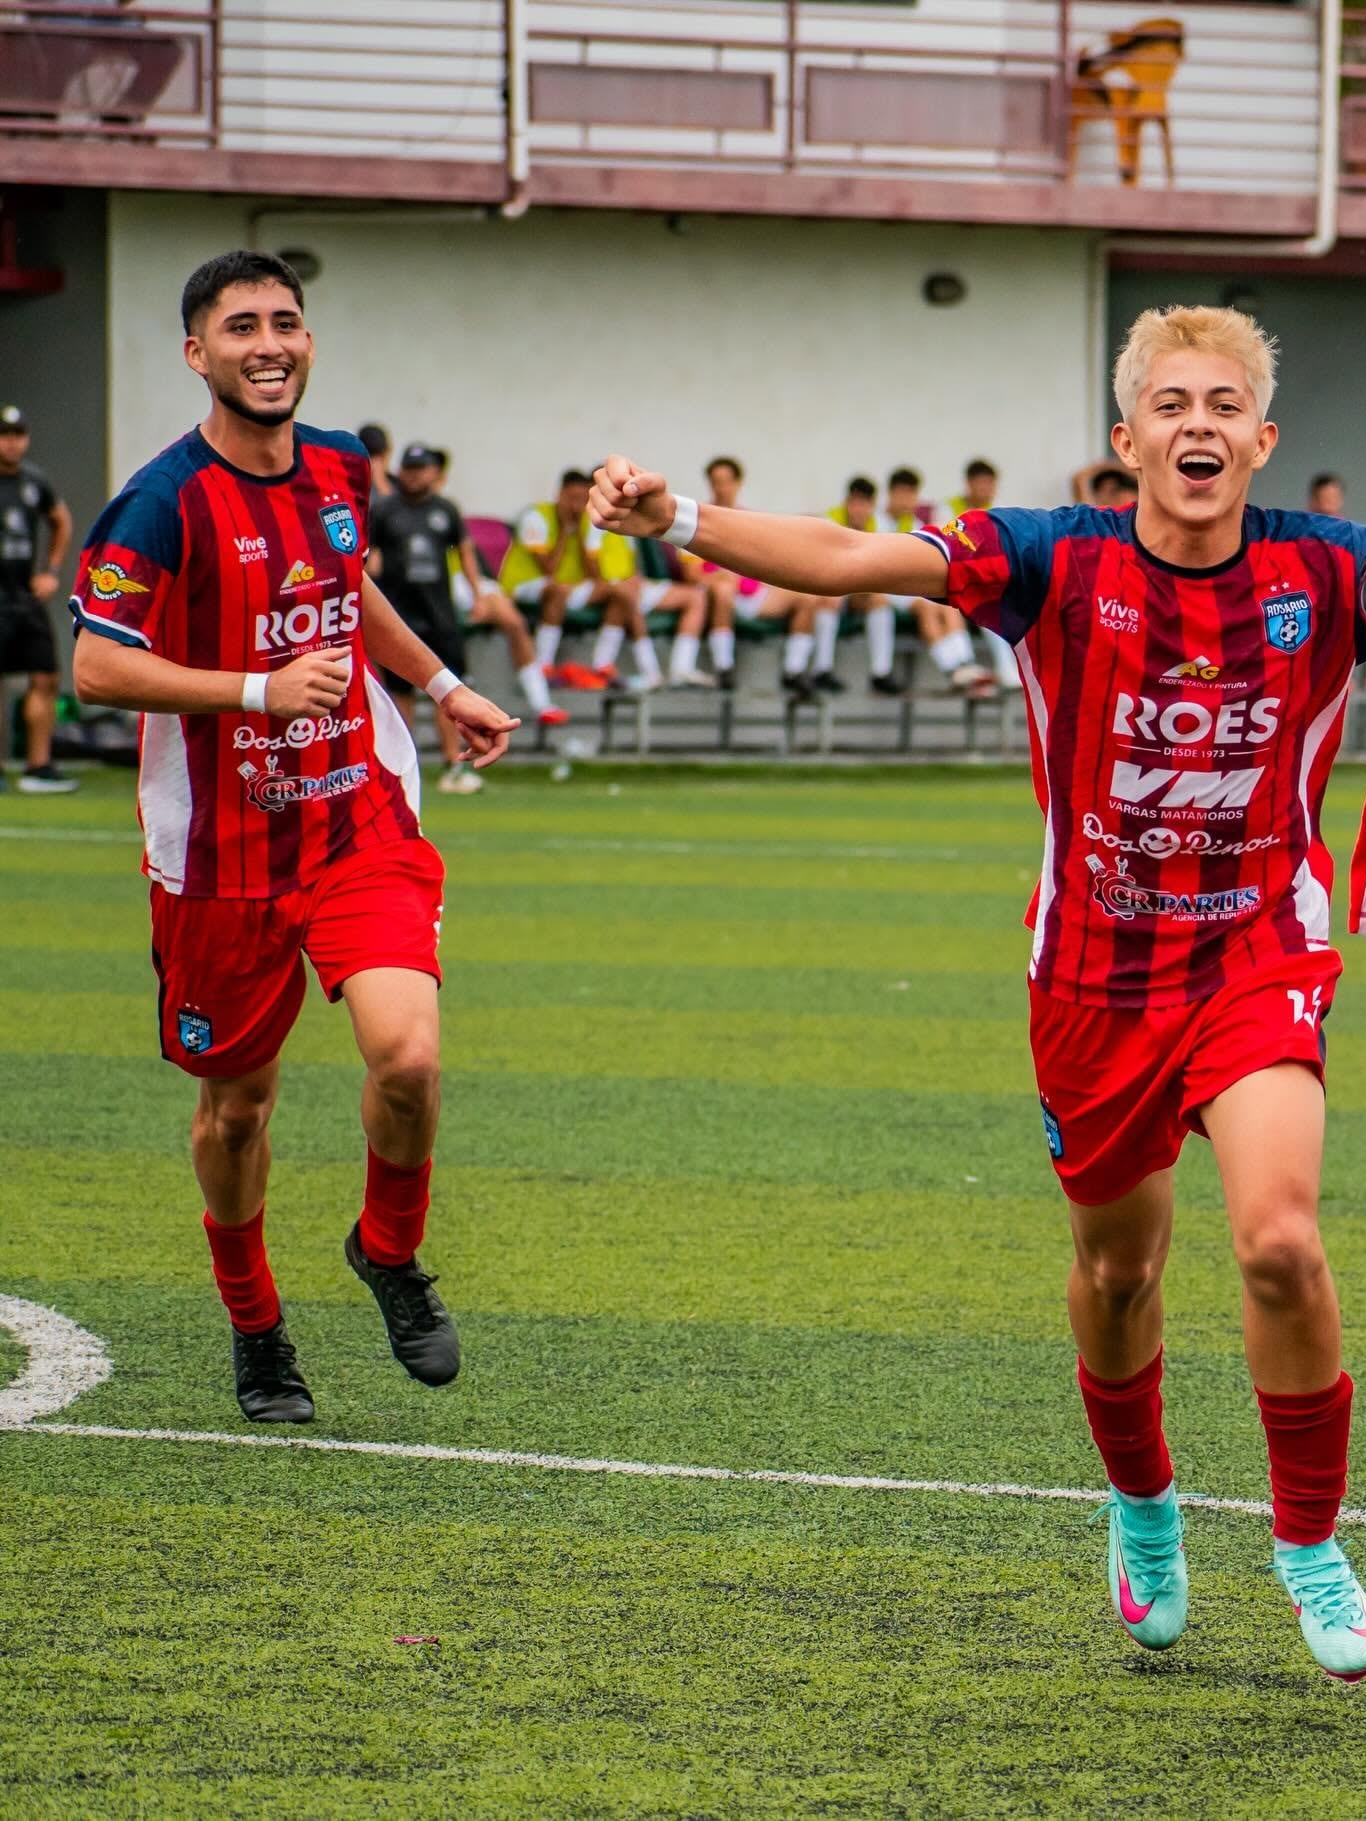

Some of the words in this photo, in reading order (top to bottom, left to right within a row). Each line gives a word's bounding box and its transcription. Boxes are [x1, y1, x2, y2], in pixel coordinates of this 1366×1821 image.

[234, 536, 266, 552] Vive
[239, 549, 269, 564] sports
[1098, 596, 1139, 620] Vive
[1266, 599, 1308, 618] ROSARIO
[1099, 616, 1139, 634] sports
[291, 644, 314, 656] DESDE
[315, 640, 332, 651] 1973
[1174, 659, 1221, 680] AG
[1158, 677, 1208, 689] ENDEREZADO
[1214, 681, 1248, 690] PINTURA
[233, 726, 287, 749] Dos
[1163, 747, 1198, 758] DESDE
[1200, 748, 1225, 758] 1973
[1109, 759, 1266, 808] VM
[1108, 800, 1157, 819] VARGAS
[1160, 809, 1244, 821] MATAMOROS
[1082, 812, 1140, 852] Dos
[1180, 830, 1281, 855] Pinos
[1113, 886, 1152, 912] CR
[1156, 885, 1261, 914] PARTES
[1171, 912, 1205, 922] AGENCIA
[1207, 912, 1218, 921] DE
[179, 1013, 210, 1031] ROSARIO
